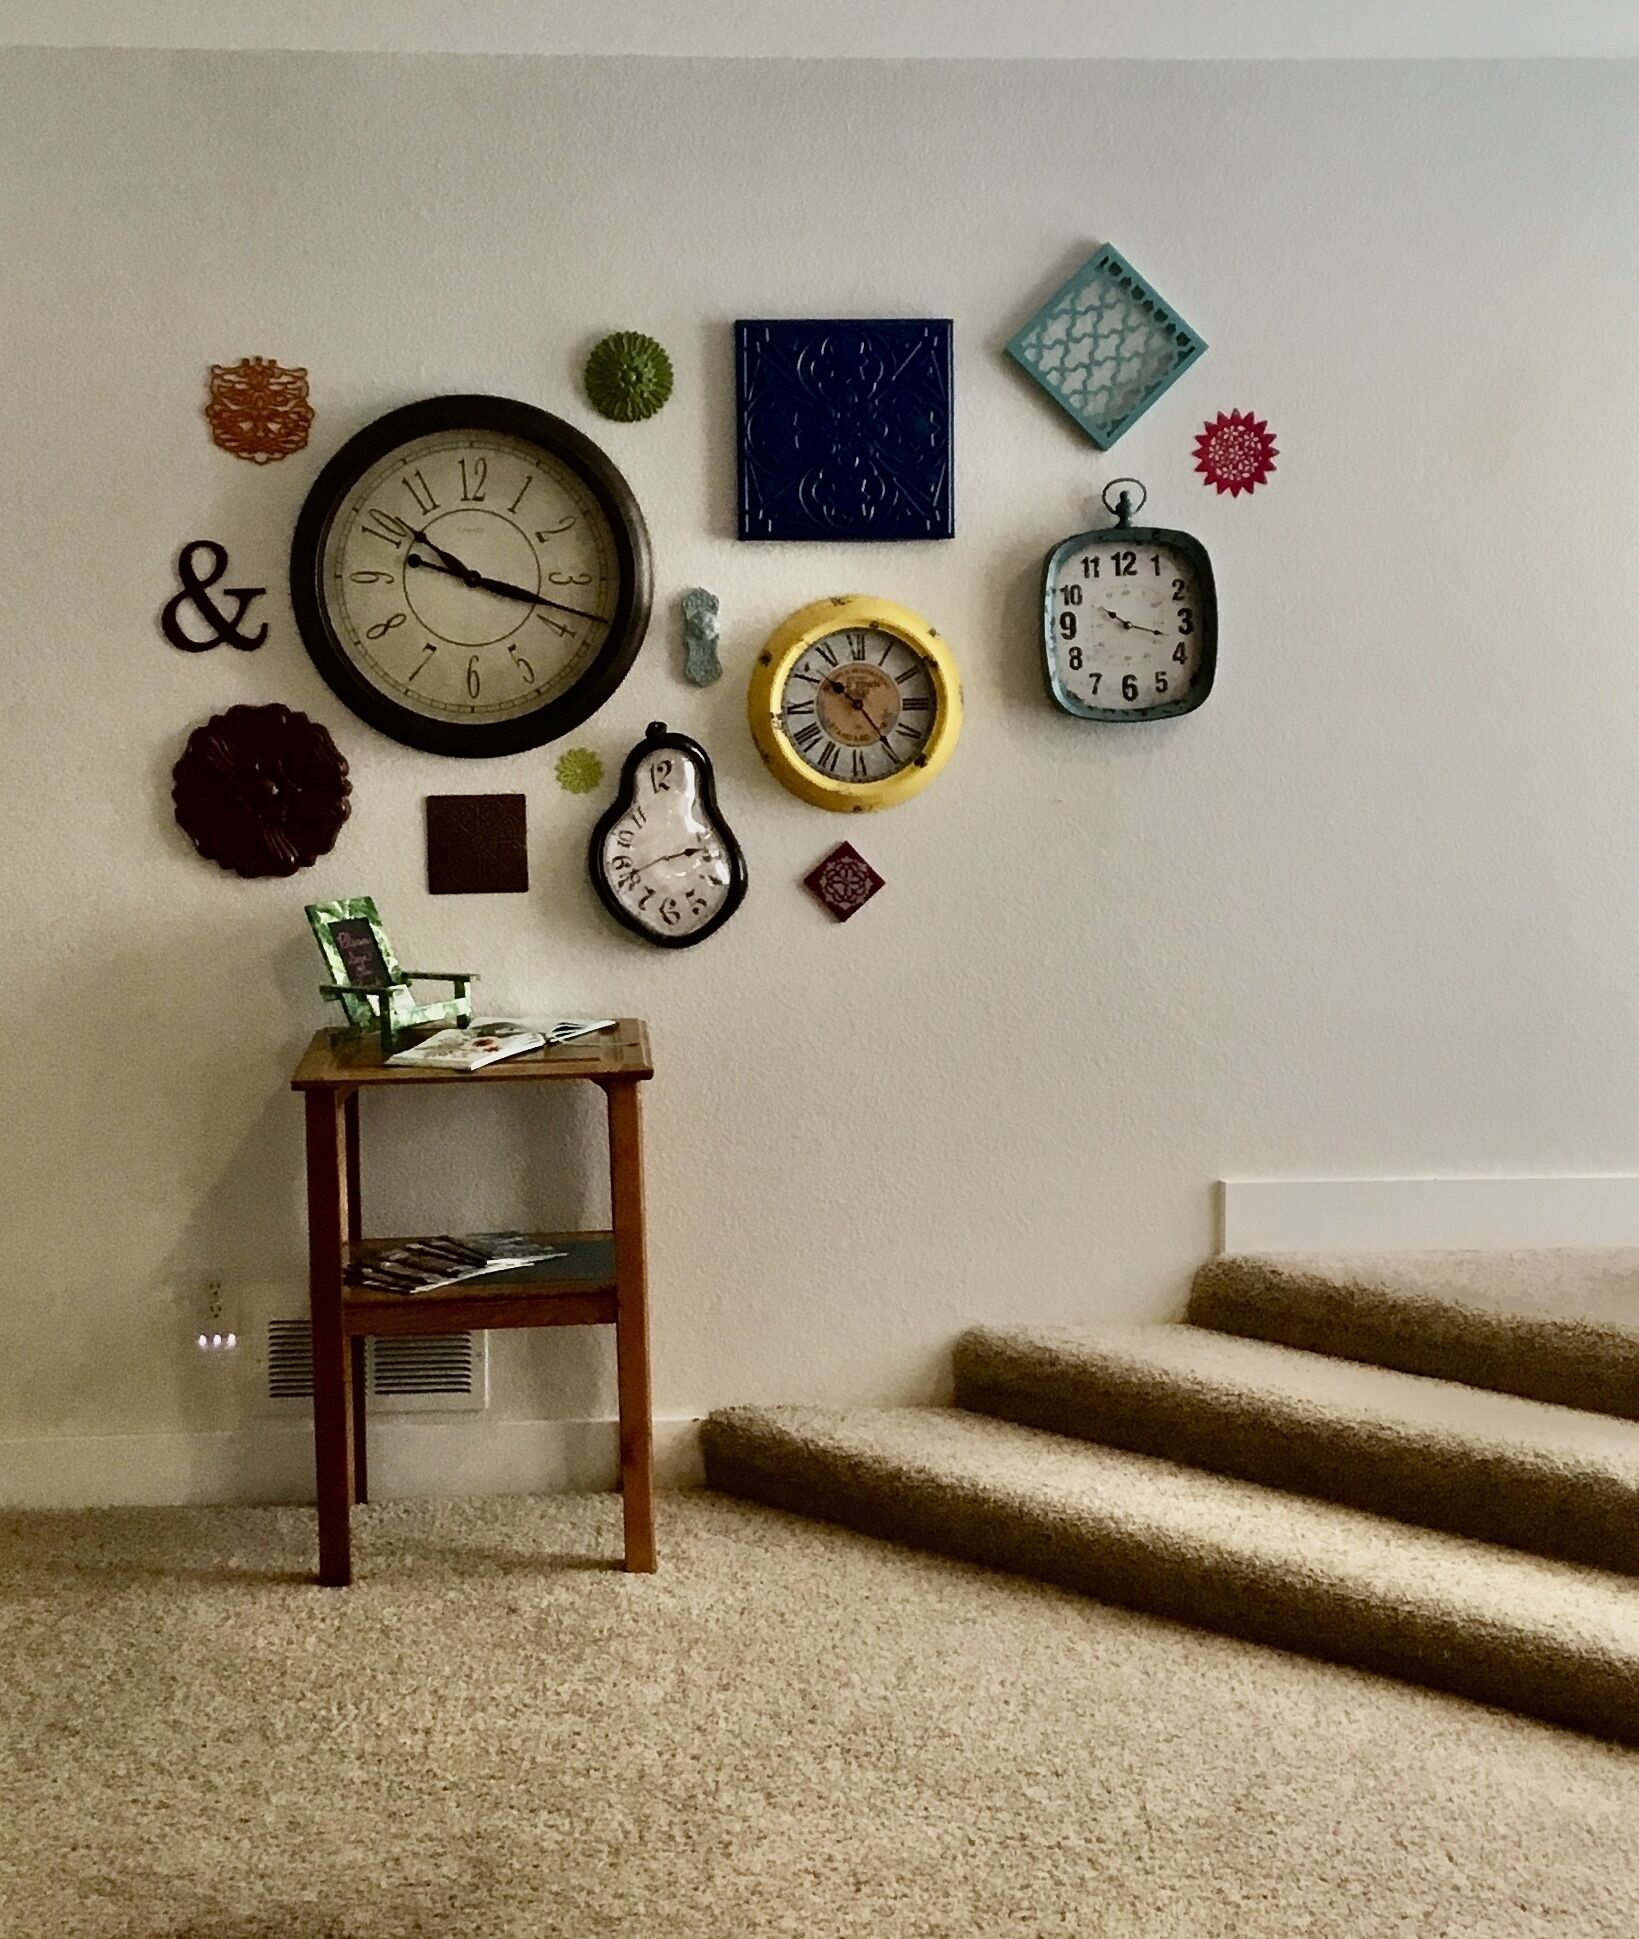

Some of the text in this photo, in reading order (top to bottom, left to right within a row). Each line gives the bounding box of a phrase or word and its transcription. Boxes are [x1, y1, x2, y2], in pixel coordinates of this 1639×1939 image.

[401, 470, 441, 515] 11
[458, 457, 487, 502] 12
[508, 476, 532, 514] 1
[361, 508, 407, 550] 10
[535, 516, 577, 543] 2
[350, 570, 395, 585] 9
[1081, 556, 1100, 578] 11
[1110, 551, 1138, 577] 12
[1150, 554, 1161, 576] 1
[548, 572, 593, 587] 3
[1172, 579, 1185, 601] 2
[1060, 584, 1083, 606] 10
[366, 613, 406, 640] 8
[537, 613, 577, 640] 4
[1059, 611, 1077, 640] 9
[1177, 608, 1194, 635] 3
[408, 643, 437, 681] 7
[508, 645, 535, 684] 5
[878, 642, 894, 666] I
[1068, 646, 1083, 670] 8
[1172, 642, 1188, 665] 4
[466, 655, 481, 700] 6
[894, 665, 922, 685] II
[1088, 672, 1102, 695] 7
[1121, 674, 1139, 702] 6
[1155, 671, 1168, 693] 5
[902, 698, 929, 711] III
[793, 722, 823, 753] VIII
[817, 741, 840, 772] VII
[852, 749, 868, 776] VI
[650, 760, 672, 794] 12
[631, 806, 647, 829] 11
[617, 829, 634, 848] 10
[612, 855, 632, 870] 9
[638, 886, 656, 911] 7
[659, 897, 681, 925] 6
[685, 888, 708, 915] 5
